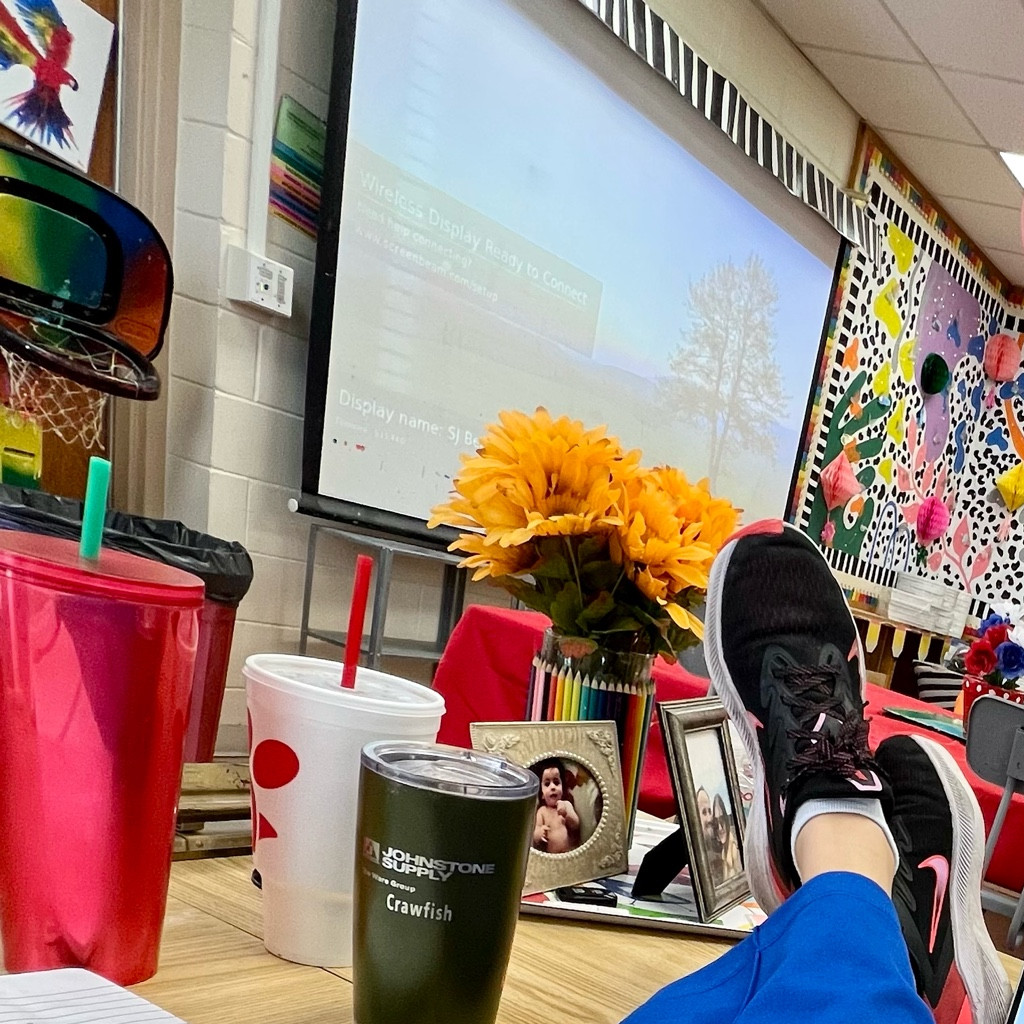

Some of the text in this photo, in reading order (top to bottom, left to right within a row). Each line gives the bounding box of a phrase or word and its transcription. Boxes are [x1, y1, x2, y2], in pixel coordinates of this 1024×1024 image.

[360, 170, 423, 218] Wireless
[428, 206, 480, 252] Display
[484, 237, 523, 273] Ready
[526, 262, 539, 280] to
[542, 270, 588, 305] Connect
[338, 388, 395, 424] Display
[398, 412, 443, 438] name:
[447, 425, 461, 446] SJ
[464, 430, 483, 448] Be
[381, 847, 496, 875] JOHNSTONE
[381, 857, 452, 882] SUPPLY
[390, 878, 417, 893] Group
[386, 893, 453, 922] Crawfish
